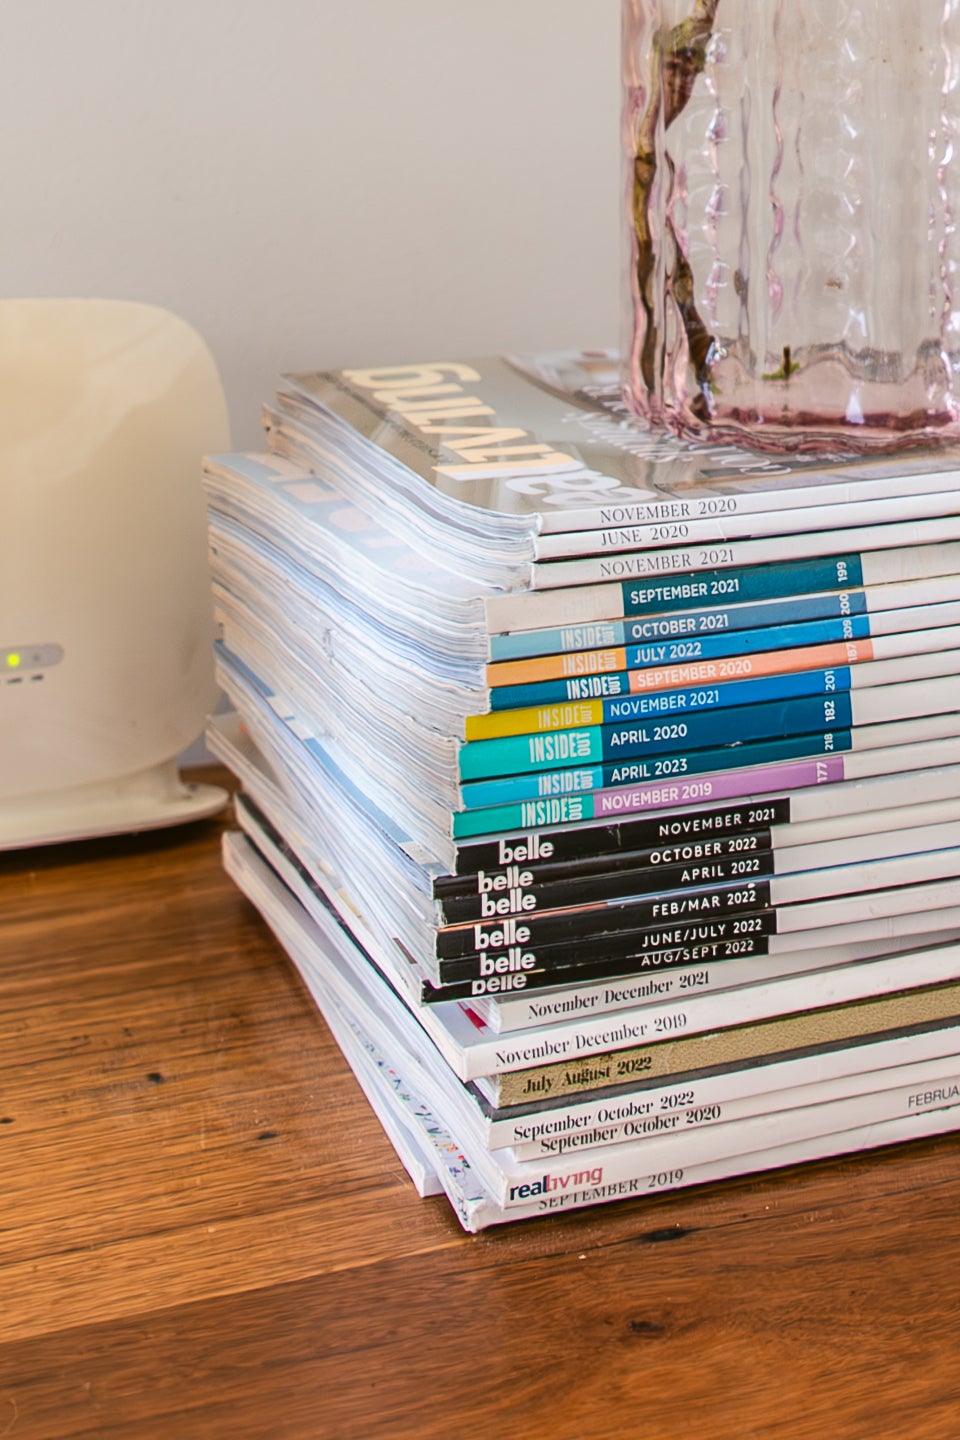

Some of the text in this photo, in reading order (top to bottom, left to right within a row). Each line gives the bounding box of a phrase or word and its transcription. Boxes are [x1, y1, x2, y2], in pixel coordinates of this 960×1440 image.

[600, 498, 737, 523] NOVEMBER 2020
[600, 524, 689, 546] JUNE 2020
[600, 549, 735, 577] NOVEMBER 2021
[837, 561, 847, 582] 199
[630, 583, 708, 605] SEPTEMBER
[710, 579, 740, 596] 2021
[841, 594, 850, 615] 200
[560, 626, 615, 648] INSIDE OUT
[632, 615, 729, 638] OCTOBER 2021
[844, 620, 852, 638] 209
[563, 651, 616, 674] INSIDE OUT
[634, 643, 702, 664] JULY 2022
[637, 660, 752, 687] SEPTEMBER 2020
[825, 670, 835, 690] 201
[566, 676, 621, 700] INSIDE OUT
[610, 690, 720, 716] NOVEMBER 2021
[825, 700, 835, 722] 182
[538, 704, 592, 728] INSIDE OUT
[529, 730, 590, 763] INSIDE OUT
[610, 724, 687, 746] APRIL 2020
[825, 734, 833, 750] 218
[611, 759, 687, 782] APRIL 2023
[818, 762, 828, 782] 177
[538, 770, 593, 796] INSIDE OUT
[602, 783, 712, 811] NOVEMBER 2019
[522, 797, 582, 828] INSIDE OUT
[659, 808, 776, 836] NOVEMBER 2021
[500, 836, 554, 864] belle
[650, 837, 757, 864] OCTOBER 2022
[478, 866, 534, 894] belle
[681, 859, 760, 882] APRIL 2022
[481, 888, 536, 916] belle
[652, 890, 756, 917] FEB/MAR 2022
[474, 920, 530, 950] belle
[642, 918, 762, 948] JUNE/JULY 2022
[480, 948, 536, 976] belle
[640, 940, 754, 966] AUG/SEPT 2022
[472, 974, 527, 995] belle
[679, 970, 710, 989] 2021
[654, 1014, 687, 1032] 2019
[617, 1056, 652, 1074] 2022
[660, 1090, 694, 1110] 2022
[686, 1105, 722, 1124] 2020
[538, 1168, 684, 1210] SEPTEMBER 2019
